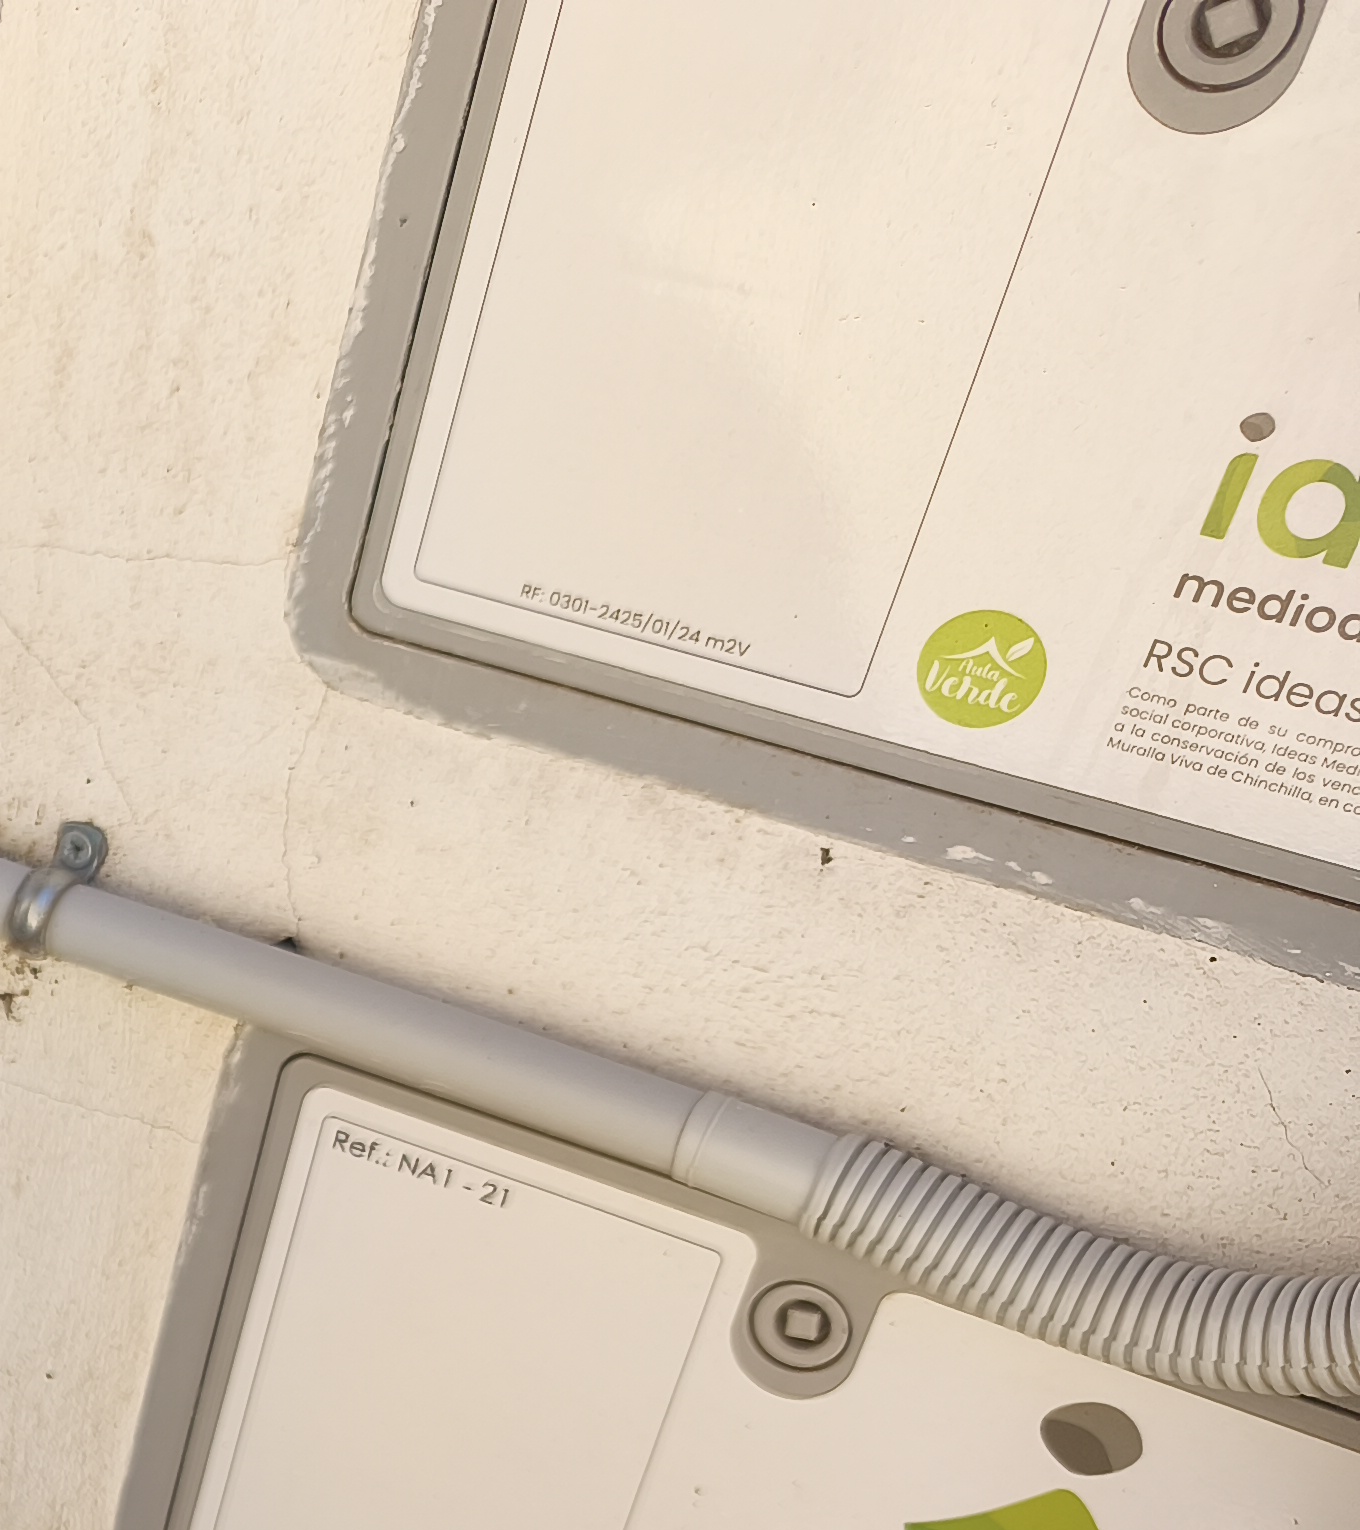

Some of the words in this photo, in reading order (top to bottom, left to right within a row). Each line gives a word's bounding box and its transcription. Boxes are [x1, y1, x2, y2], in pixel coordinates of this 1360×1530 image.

[520, 583, 546, 603] RF:
[549, 591, 701, 645] 0301-2425/01/24
[704, 635, 751, 657] m2V
[924, 659, 1021, 713] Verde
[958, 658, 1001, 682] Aula
[1143, 638, 1234, 686] RSC
[1120, 704, 1170, 726] social
[1171, 717, 1267, 754] corporativa,
[1271, 743, 1318, 766] Ideas
[1128, 686, 1178, 709] Como
[1183, 702, 1230, 723] parte
[1237, 714, 1259, 730] de
[1267, 723, 1288, 738] su
[1106, 736, 1166, 762] Muralla
[1170, 752, 1204, 772] Viva
[1206, 762, 1228, 779] de
[1231, 769, 1314, 804] Chinchilla,
[1318, 794, 1340, 810] en
[1114, 721, 1125, 733] a
[1130, 722, 1146, 738] la
[1150, 732, 1259, 769] conservación
[1264, 759, 1287, 777] de
[1291, 766, 1316, 784] los
